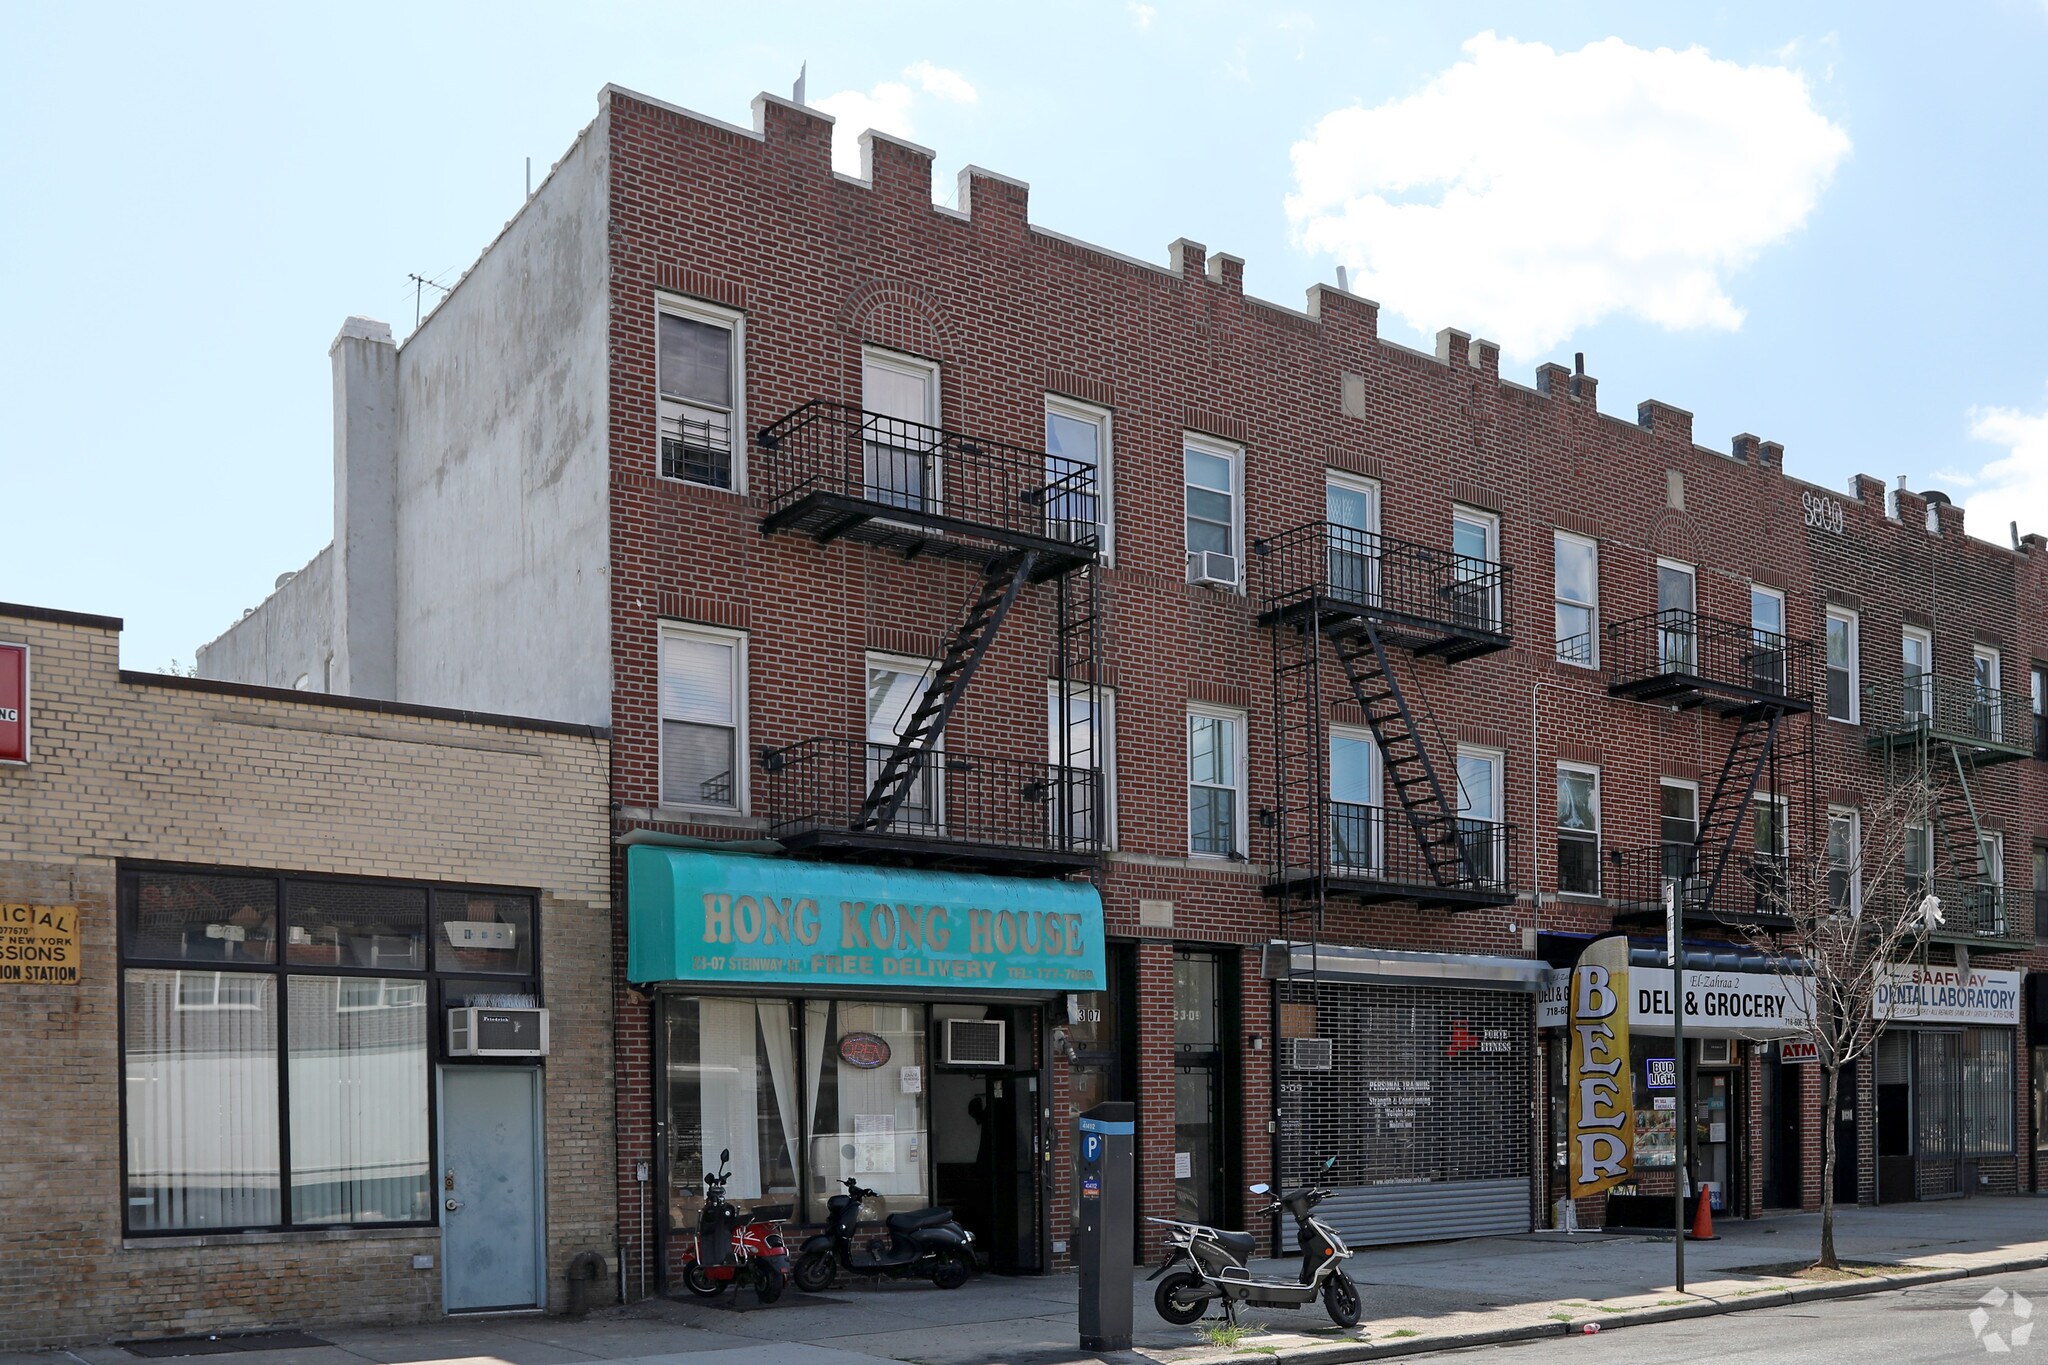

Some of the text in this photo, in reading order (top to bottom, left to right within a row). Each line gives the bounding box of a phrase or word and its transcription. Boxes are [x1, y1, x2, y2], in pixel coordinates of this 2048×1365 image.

[702, 893, 1085, 957] HONG KONG HOUSE
[9, 936, 35, 945] NEW
[40, 938, 72, 946] YORK
[25, 965, 76, 980] STATION
[729, 957, 783, 972] STEINWAY
[811, 954, 873, 975] FREE
[882, 957, 997, 979] DELIVERY
[1690, 975, 1740, 989] El-Zahraa 2
[1538, 986, 1555, 1003] DELI
[1556, 985, 1562, 1002] &
[1879, 984, 2016, 1010] DENTAL LABORATORY
[1639, 989, 1786, 1018] DEL & GROCERY
[841, 1041, 885, 1062] OPEN
[1481, 1042, 1511, 1052] FITNESS
[1782, 1043, 1817, 1057] ATM
[1576, 964, 1628, 1185] BEER
[1652, 1061, 1675, 1074] BUD
[1369, 1080, 1430, 1091] PERSONAL TRAINING
[1369, 1096, 1392, 1106] Strength
[1088, 1136, 1098, 1158] P
